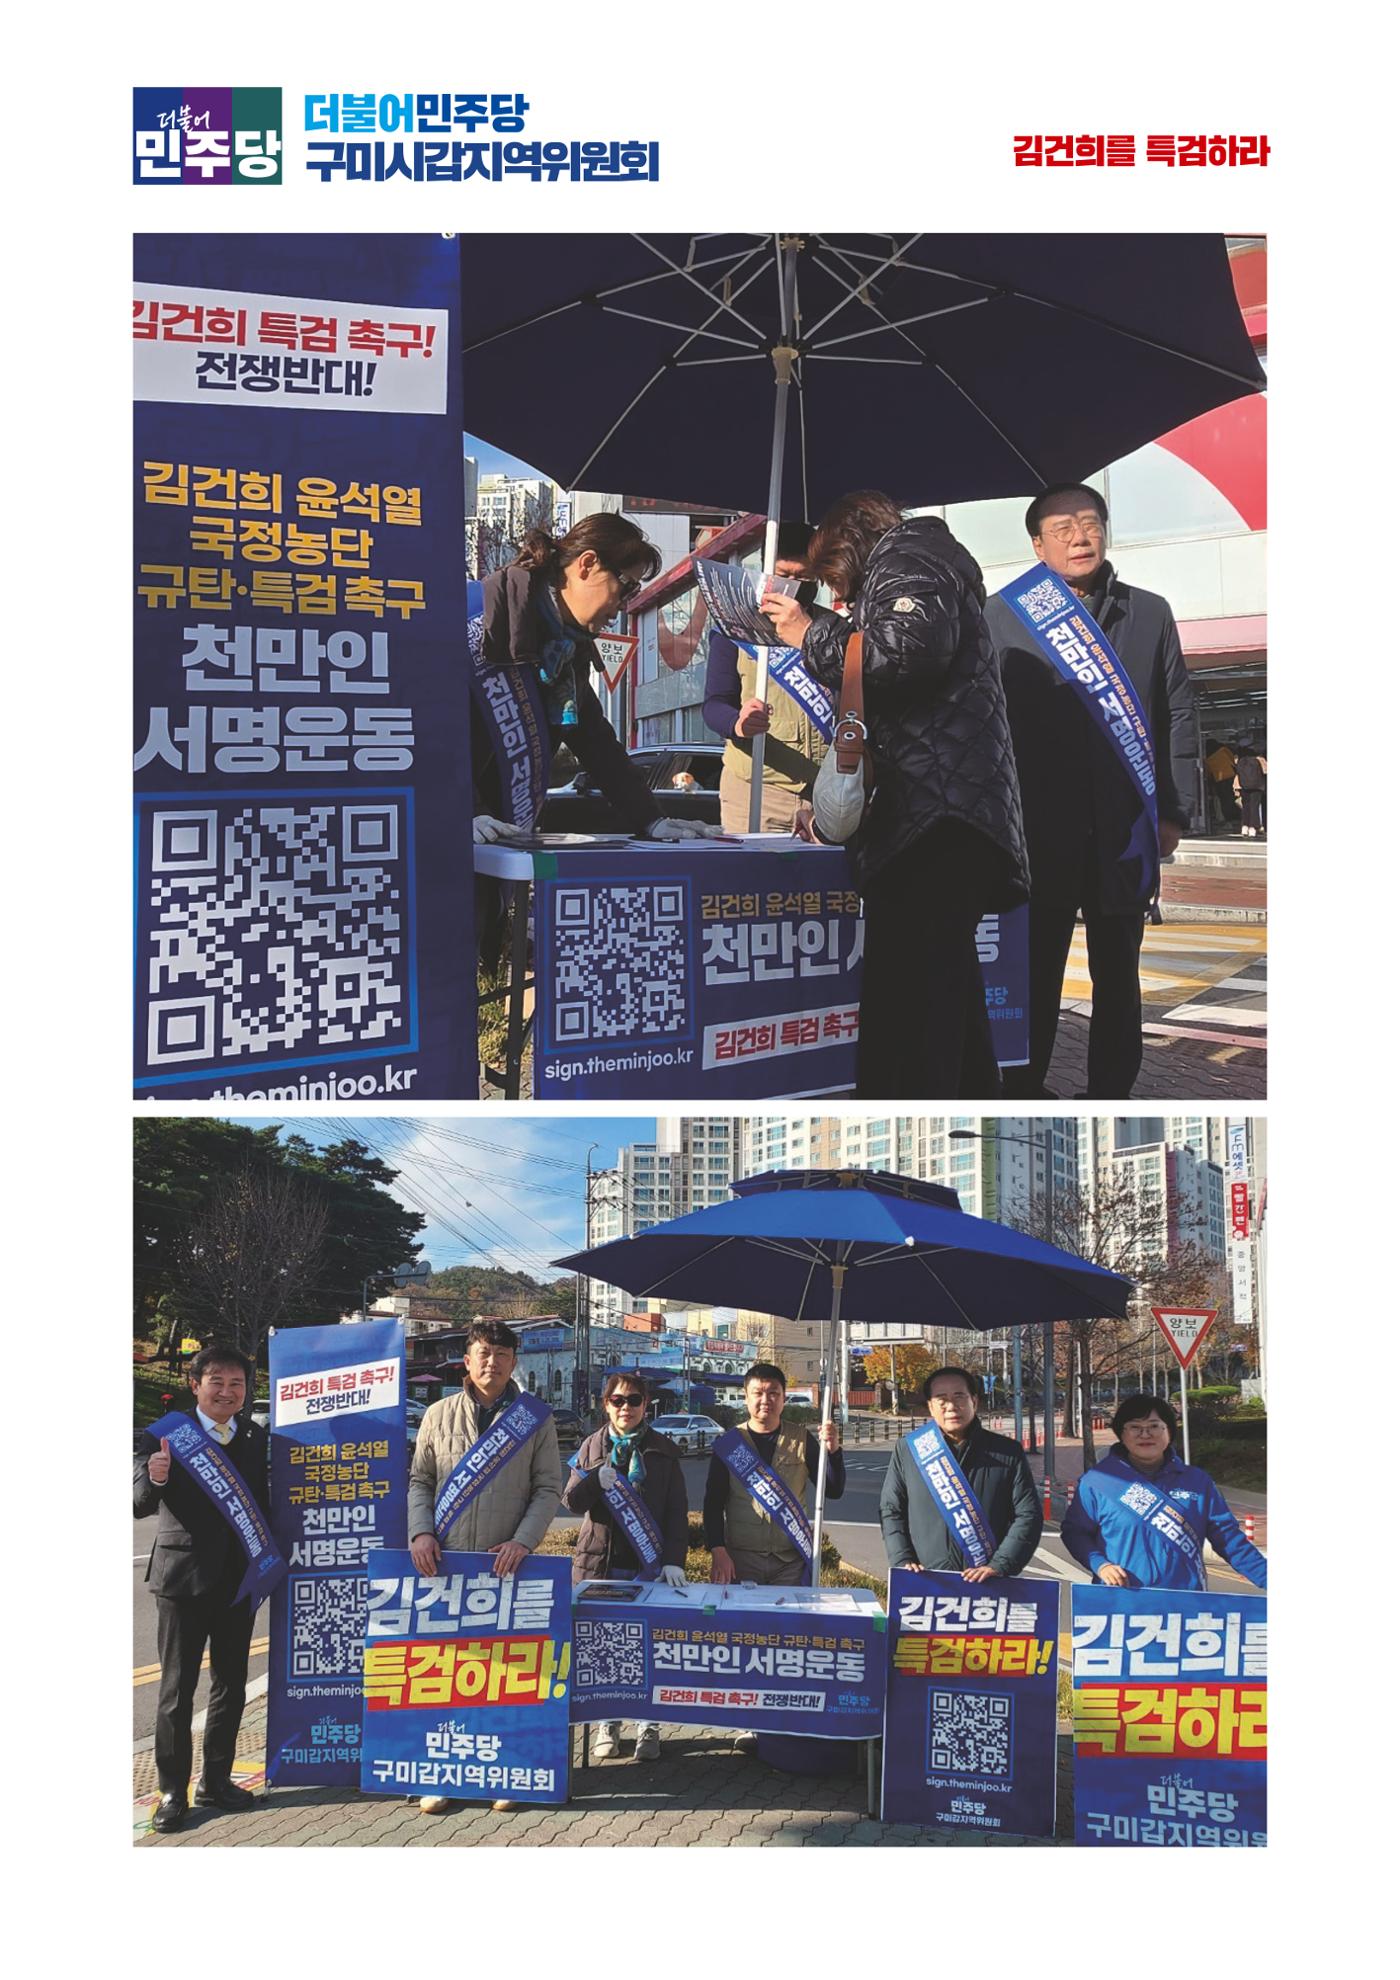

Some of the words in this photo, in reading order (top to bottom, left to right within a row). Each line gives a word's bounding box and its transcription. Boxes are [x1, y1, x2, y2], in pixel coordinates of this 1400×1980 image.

[133, 300, 246, 346] 김건희
[257, 311, 337, 352] 특검
[347, 318, 436, 358] 촉구!
[195, 351, 377, 397] 전쟁반대!
[143, 461, 282, 514] 김건희
[296, 477, 422, 526] 윤석열
[190, 516, 374, 568] 국정농단
[138, 564, 337, 616] 규탄·특검
[344, 575, 426, 620] 촉구
[182, 623, 391, 695] 천만인
[601, 642, 624, 655] 양보
[602, 654, 624, 664] YIELD
[1046, 622, 1108, 696] 천만인
[783, 665, 833, 725] 천만인
[482, 671, 528, 758] 천만인
[133, 705, 415, 774] 서명운동
[701, 893, 760, 920] 김건희
[766, 891, 821, 917] 윤석열
[827, 890, 861, 914] 국정
[702, 919, 841, 986] 천만인
[714, 1023, 777, 1061] 김건희
[780, 1016, 820, 1047] 특검
[544, 1047, 695, 1083] sign.theminjoo.kr
[1169, 1317, 1197, 1329] 양보
[1172, 1329, 1198, 1337] YIELD
[280, 1379, 323, 1402] 김건희
[327, 1373, 358, 1392] 특검
[360, 1366, 395, 1386] 촉구!
[305, 1388, 372, 1416] 전쟁반대!
[290, 1443, 337, 1465] 김건희
[340, 1440, 389, 1461] 윤석열
[466, 1428, 511, 1474] 천만인
[188, 1451, 233, 1500] 천만인
[305, 1462, 370, 1483] 국정농단
[925, 1459, 961, 1510] 천만인
[289, 1483, 356, 1505] 규탄·특검
[358, 1481, 391, 1500] 촉구
[302, 1505, 377, 1536] 천만인
[1151, 1511, 1198, 1559] 천만인
[289, 1536, 385, 1567] 서명운동
[367, 1572, 554, 1637] 김건희를
[899, 1596, 1039, 1633] 김건희를
[652, 1628, 688, 1642] 김건희
[691, 1630, 728, 1644] 윤석열
[731, 1632, 780, 1647] 국정농단
[840, 1637, 865, 1650] 촉구
[893, 1637, 1055, 1676] 특검하라!
[1072, 1612, 1267, 1677] 김건희를
[363, 1640, 571, 1706] 특검하라!
[652, 1642, 740, 1674] 천만인
[745, 1648, 866, 1682] 서명운동
[287, 1684, 362, 1700] sign.theminjo
[660, 1688, 697, 1704] 김건희
[700, 1691, 727, 1705] 특검
[728, 1691, 759, 1706] 촉구!
[762, 1692, 822, 1709] 전쟁반대!
[311, 1724, 362, 1745] 민주당
[426, 1731, 502, 1762] 민주당
[281, 1747, 363, 1764] 구미갑지역위
[373, 1759, 555, 1792] 구미갑지역위원회
[926, 1775, 1013, 1794] sign.theminjoo.kr
[951, 1800, 987, 1816] 민주당
[1147, 1785, 1239, 1823] 민주당
[1087, 1812, 1267, 1848] 구미갑지역위
